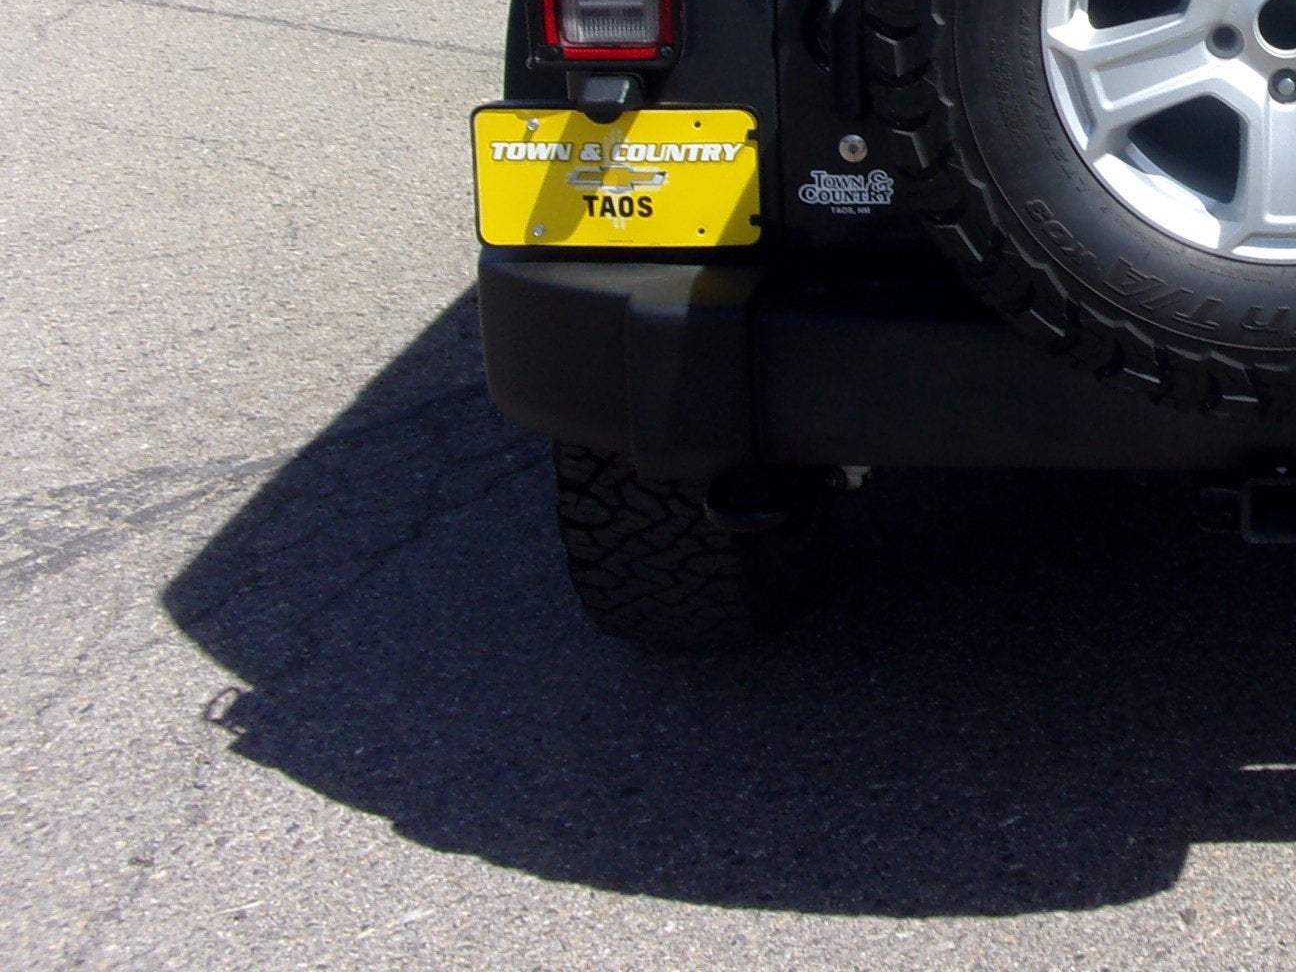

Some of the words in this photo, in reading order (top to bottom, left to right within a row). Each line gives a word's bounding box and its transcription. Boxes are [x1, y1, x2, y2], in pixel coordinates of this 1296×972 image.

[492, 142, 571, 162] TOWN
[580, 143, 603, 162] &
[612, 142, 743, 163] COUNTRY
[866, 170, 894, 191] &
[583, 195, 655, 218] TAOS
